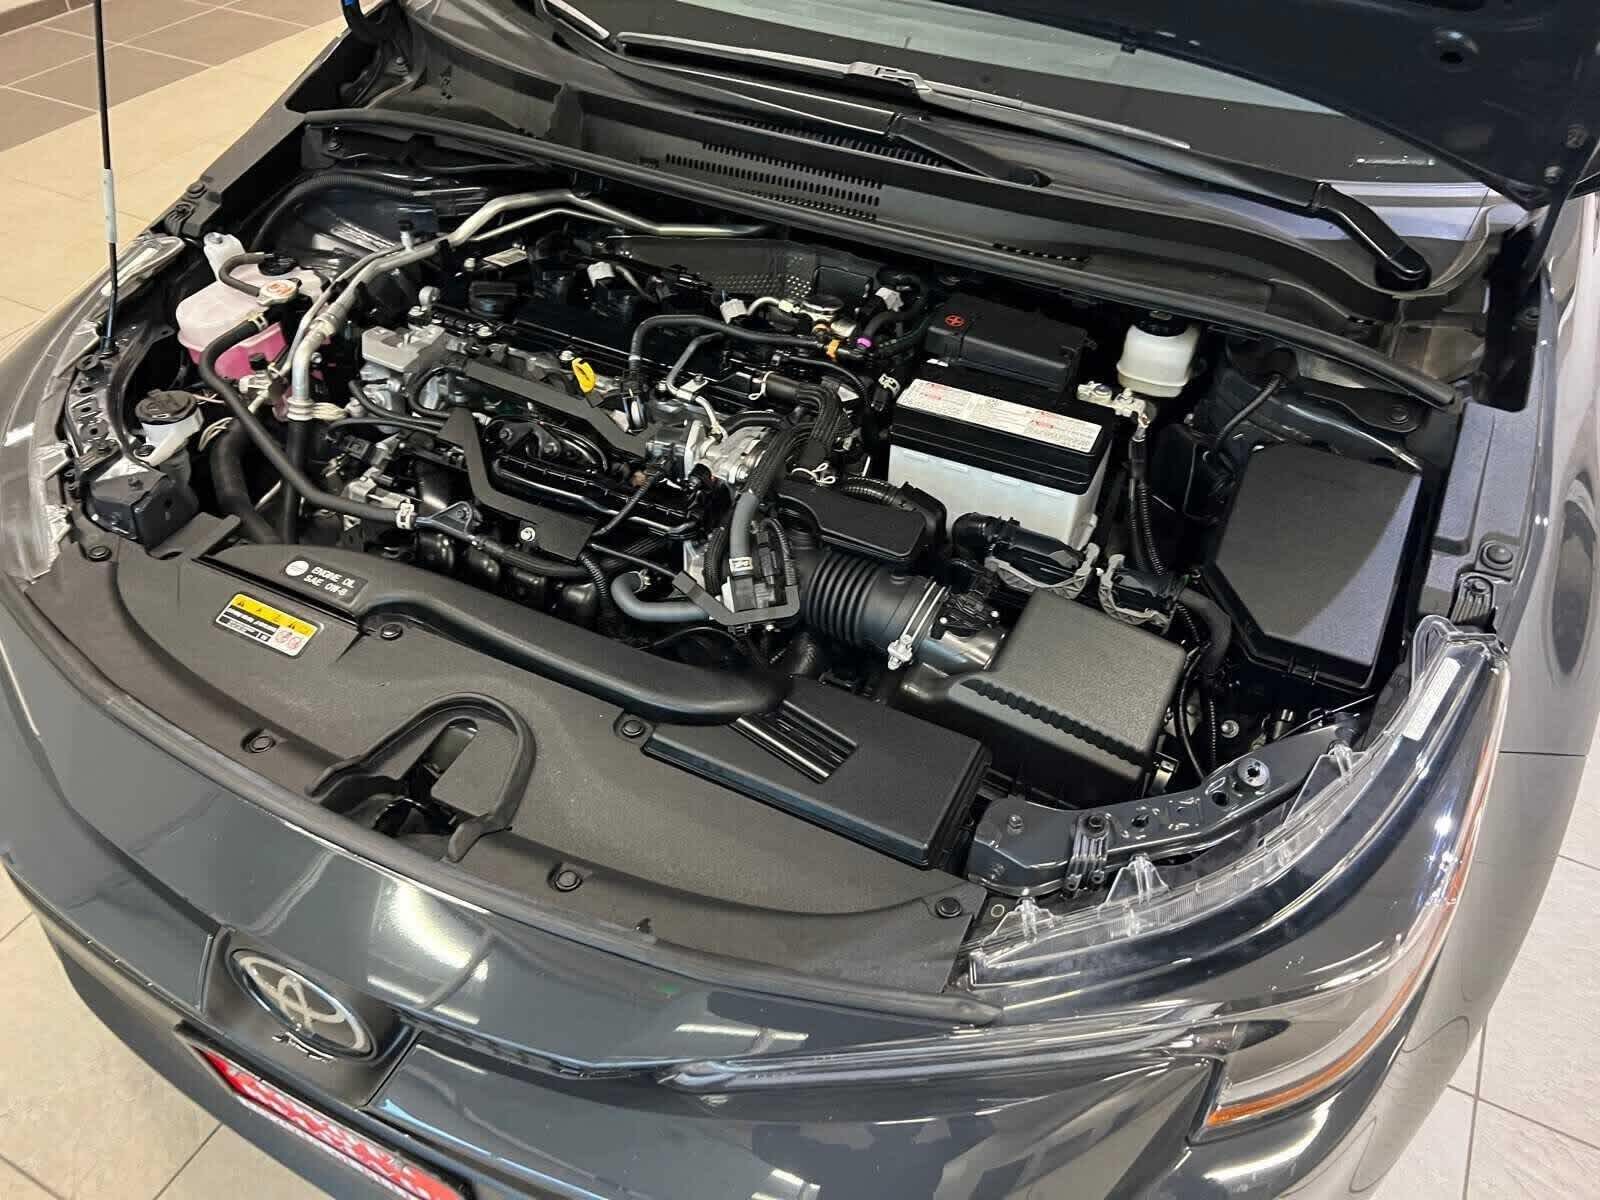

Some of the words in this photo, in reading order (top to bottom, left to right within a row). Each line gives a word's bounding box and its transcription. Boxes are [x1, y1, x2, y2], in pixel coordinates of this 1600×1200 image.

[303, 574, 325, 586] SAE
[311, 566, 342, 582] ENGINE
[342, 578, 356, 589] OIL
